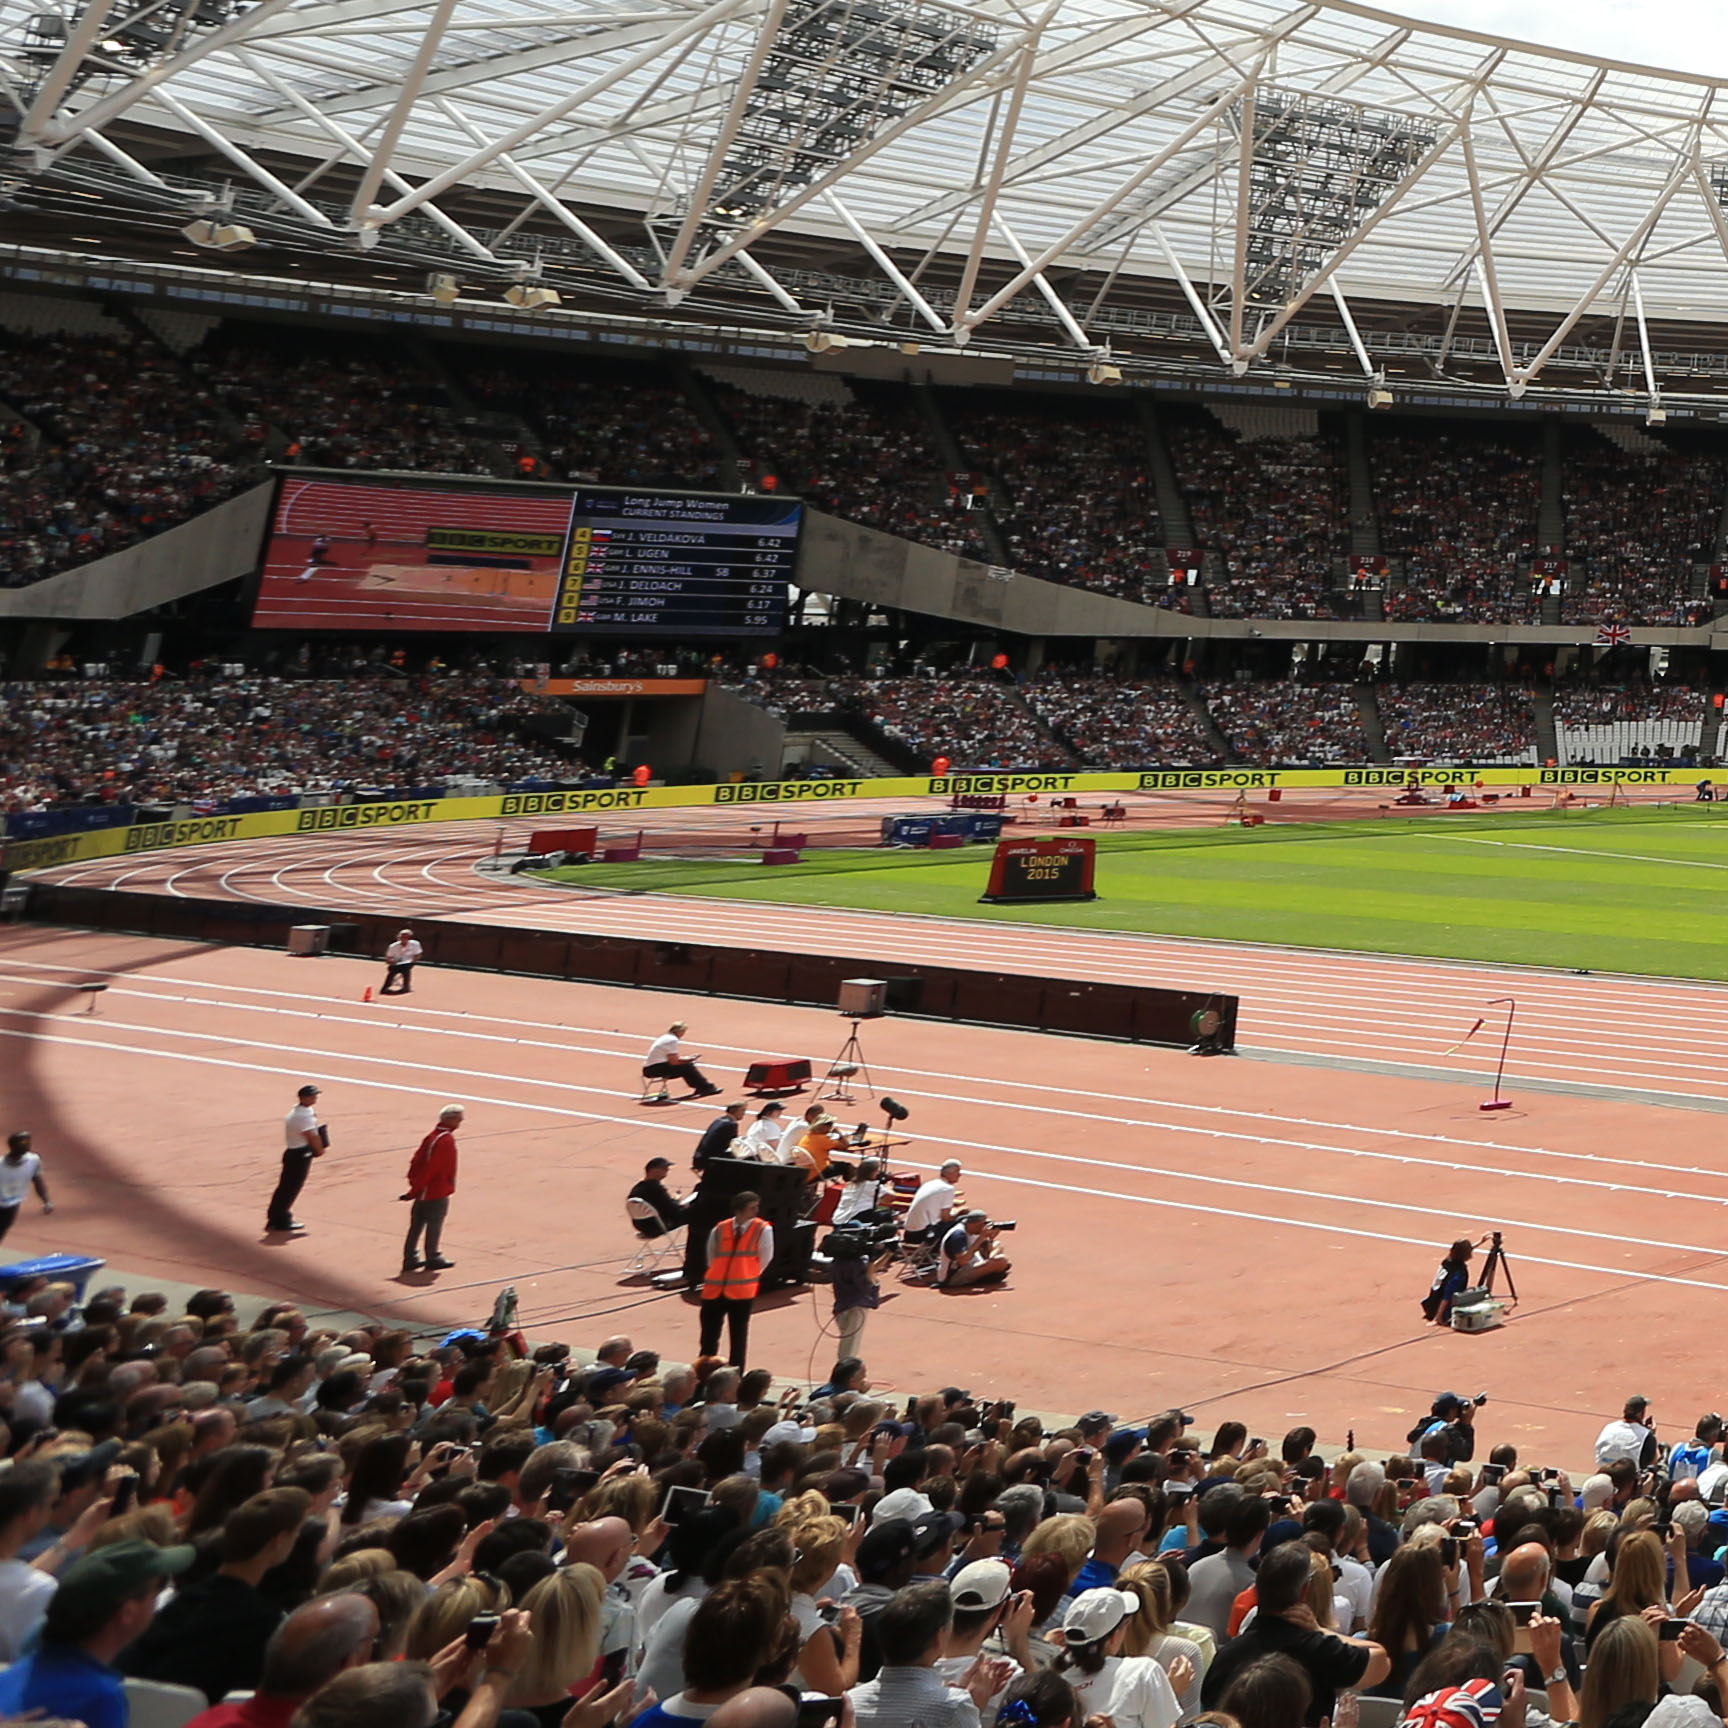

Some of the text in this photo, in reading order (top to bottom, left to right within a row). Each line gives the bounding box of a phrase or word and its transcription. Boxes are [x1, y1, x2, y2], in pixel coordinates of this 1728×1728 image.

[624, 496, 651, 508] Long
[653, 498, 684, 511] Jump
[686, 499, 729, 510] Women
[622, 508, 725, 521] CURRENT STANDINGS
[578, 530, 587, 540] 4
[757, 538, 782, 547] 6.42
[637, 549, 670, 559] UGEN
[755, 553, 779, 563] 6.42
[572, 562, 581, 572] 6
[633, 564, 693, 575] ENNIS-HILL
[752, 569, 776, 578] 6.37
[569, 578, 577, 588] 7
[630, 581, 682, 591] DELOACH
[749, 585, 773, 594] 6.24
[628, 597, 666, 607] JIMOH
[747, 600, 771, 609] 6.17
[630, 613, 659, 622] LAKE
[744, 616, 768, 625] 5.95
[573, 680, 644, 694] Sainsbury's
[930, 776, 1075, 794] BBC SPORT
[1141, 773, 1281, 788] BBC SPORT
[1344, 771, 1481, 784] BBC SPORT
[1541, 771, 1671, 784] BBC SPORT
[716, 782, 863, 802] BBC SPORT
[503, 791, 649, 814] BBC SPORT
[302, 802, 438, 829] BBC SPORT
[127, 818, 243, 850] BBC SPORT
[1020, 855, 1069, 868] LONDON
[1026, 867, 1060, 880] 2015
